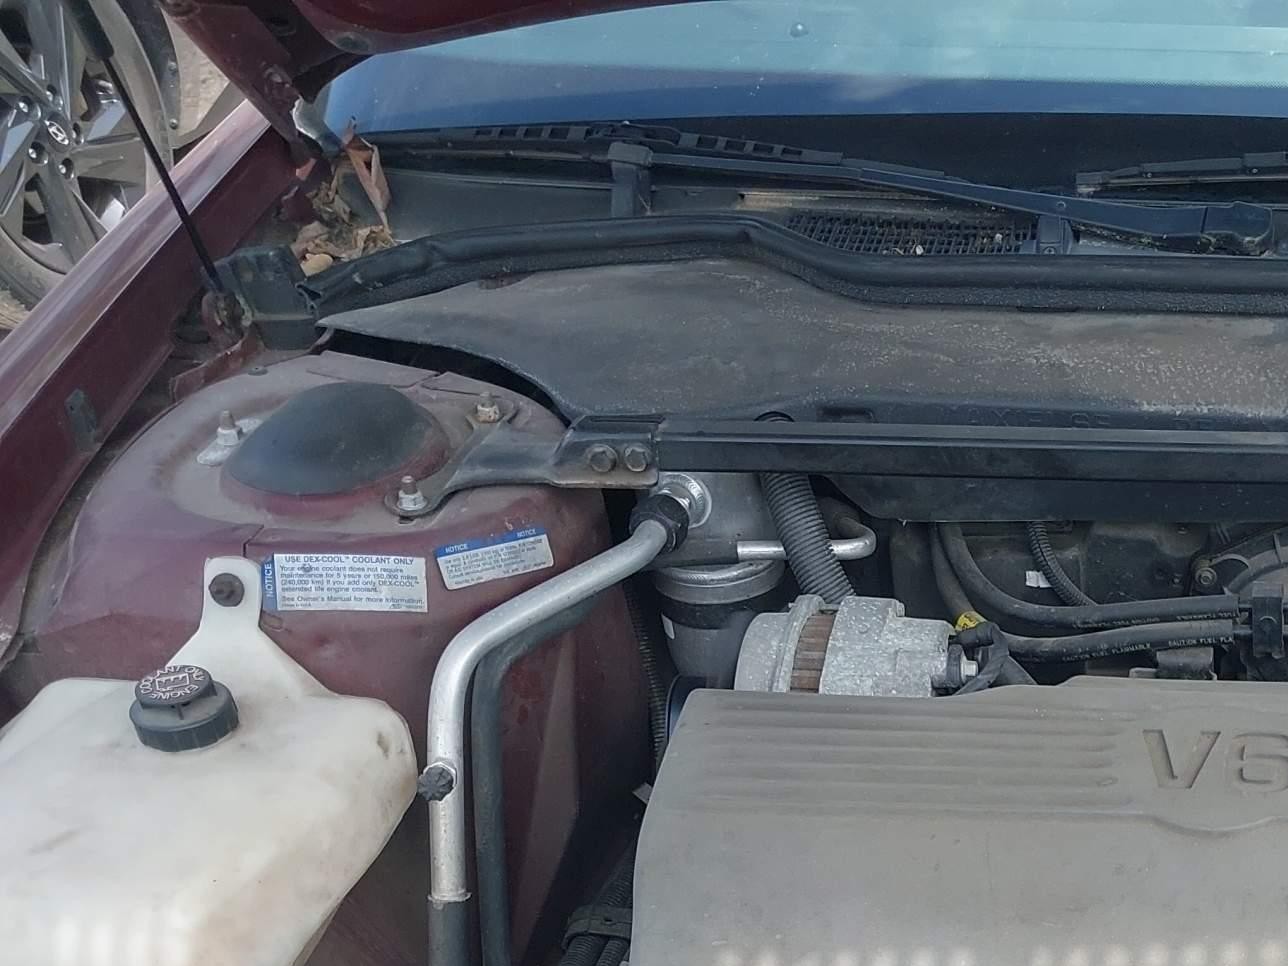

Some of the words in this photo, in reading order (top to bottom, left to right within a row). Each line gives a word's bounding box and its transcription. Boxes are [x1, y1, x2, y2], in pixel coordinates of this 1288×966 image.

[445, 543, 468, 553] NOTICE
[352, 556, 392, 564] COOLANT
[393, 557, 414, 565] ONLY
[322, 565, 346, 573] coolant
[380, 567, 404, 575] require
[264, 562, 273, 597] NOTICE
[333, 580, 345, 588] you
[361, 581, 376, 589] only
[326, 587, 350, 595] engine
